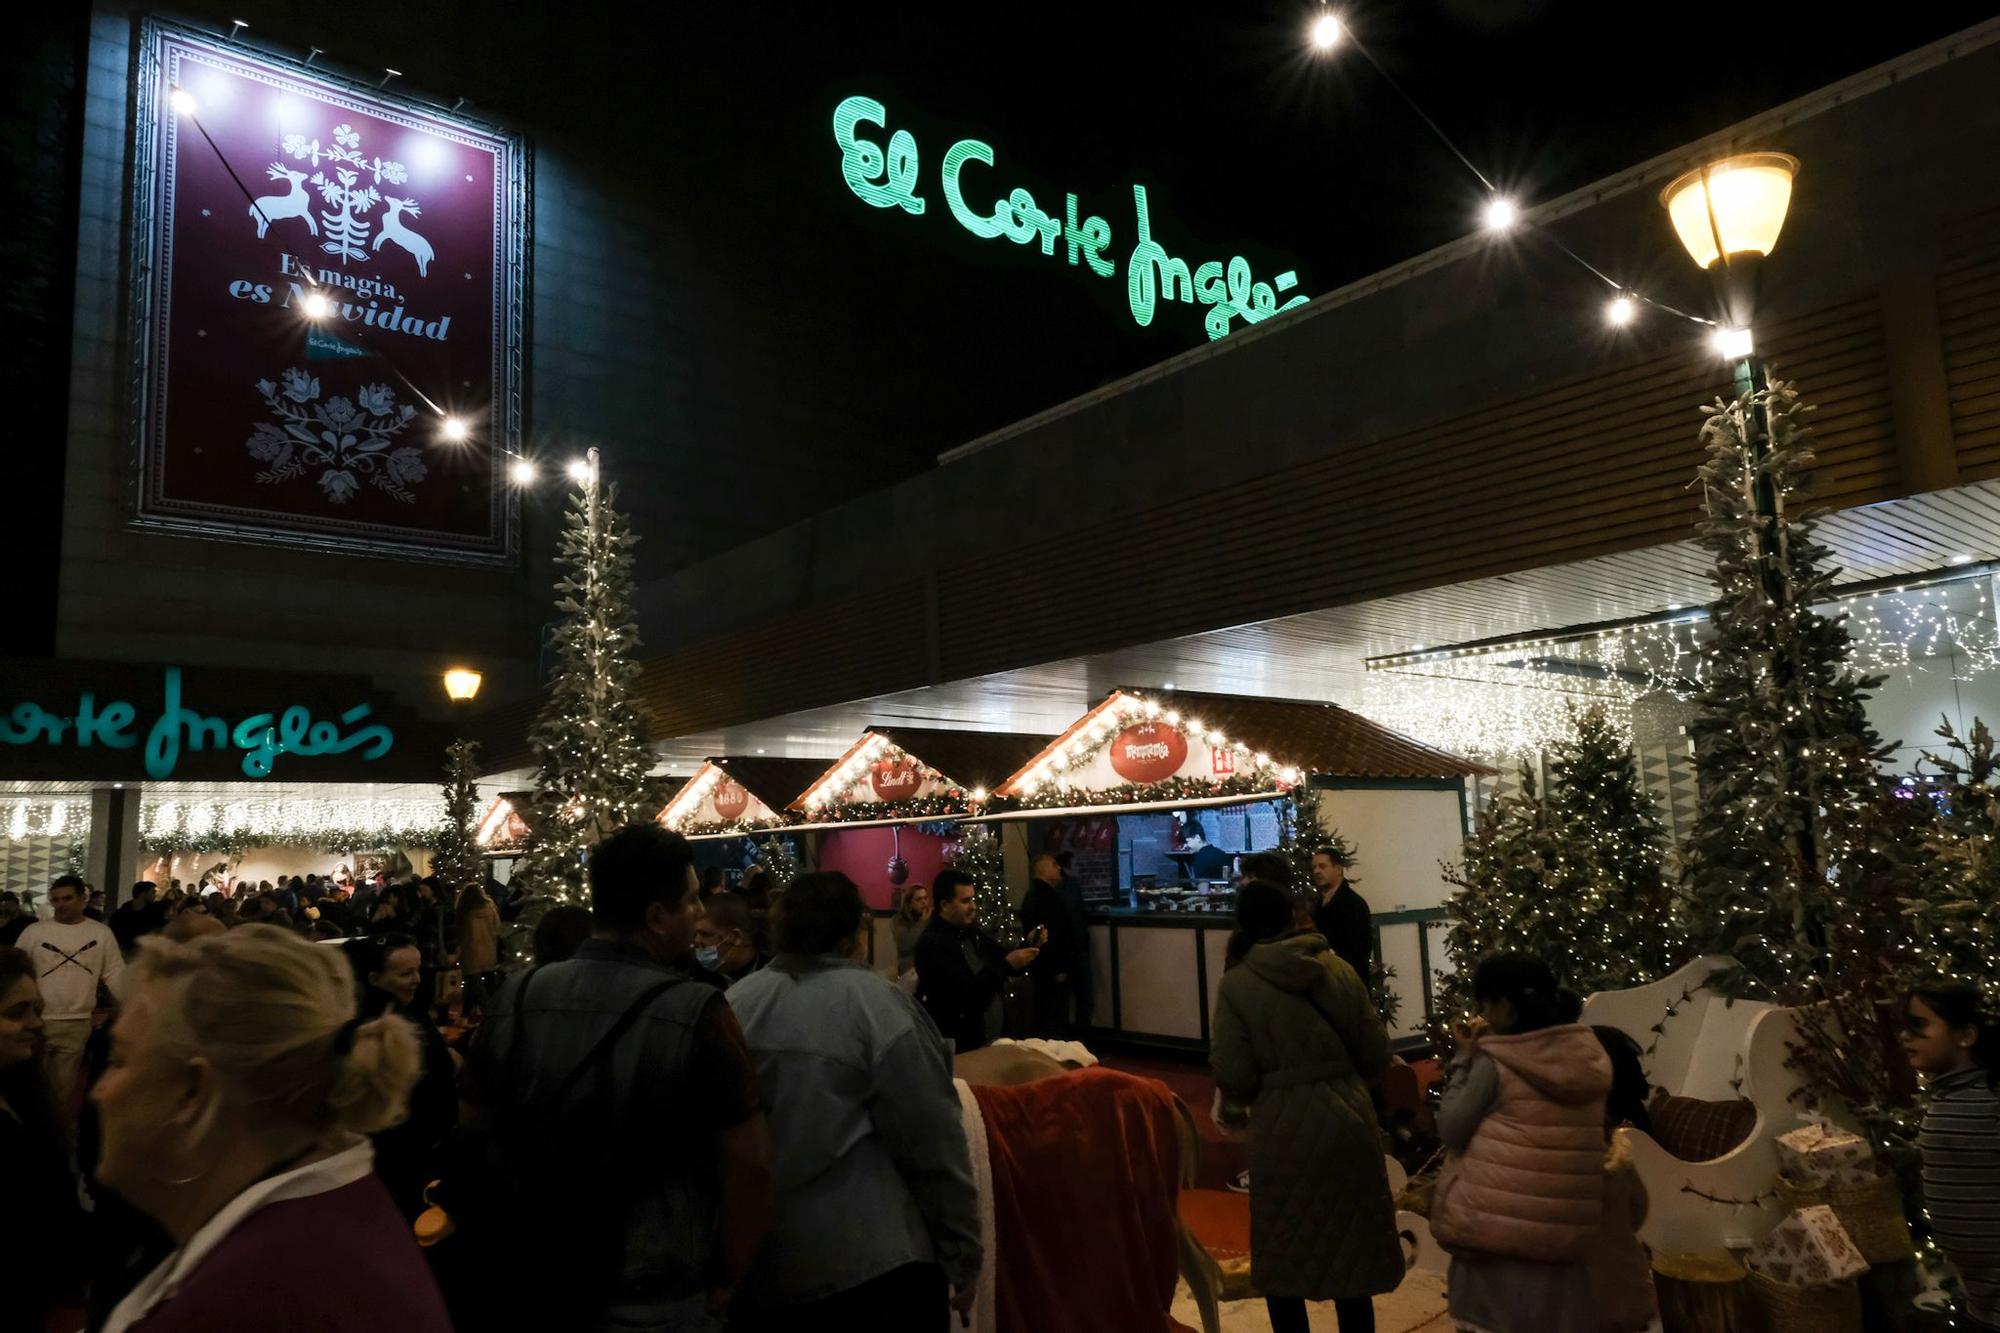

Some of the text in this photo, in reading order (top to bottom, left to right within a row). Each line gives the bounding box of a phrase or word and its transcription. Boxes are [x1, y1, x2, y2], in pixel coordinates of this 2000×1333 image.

[833, 96, 925, 215] El
[942, 139, 1115, 278] Corte
[228, 279, 273, 304] es
[280, 252, 405, 305] Es magia,
[0, 665, 394, 780] orte Inglés
[880, 769, 907, 788] Lindt
